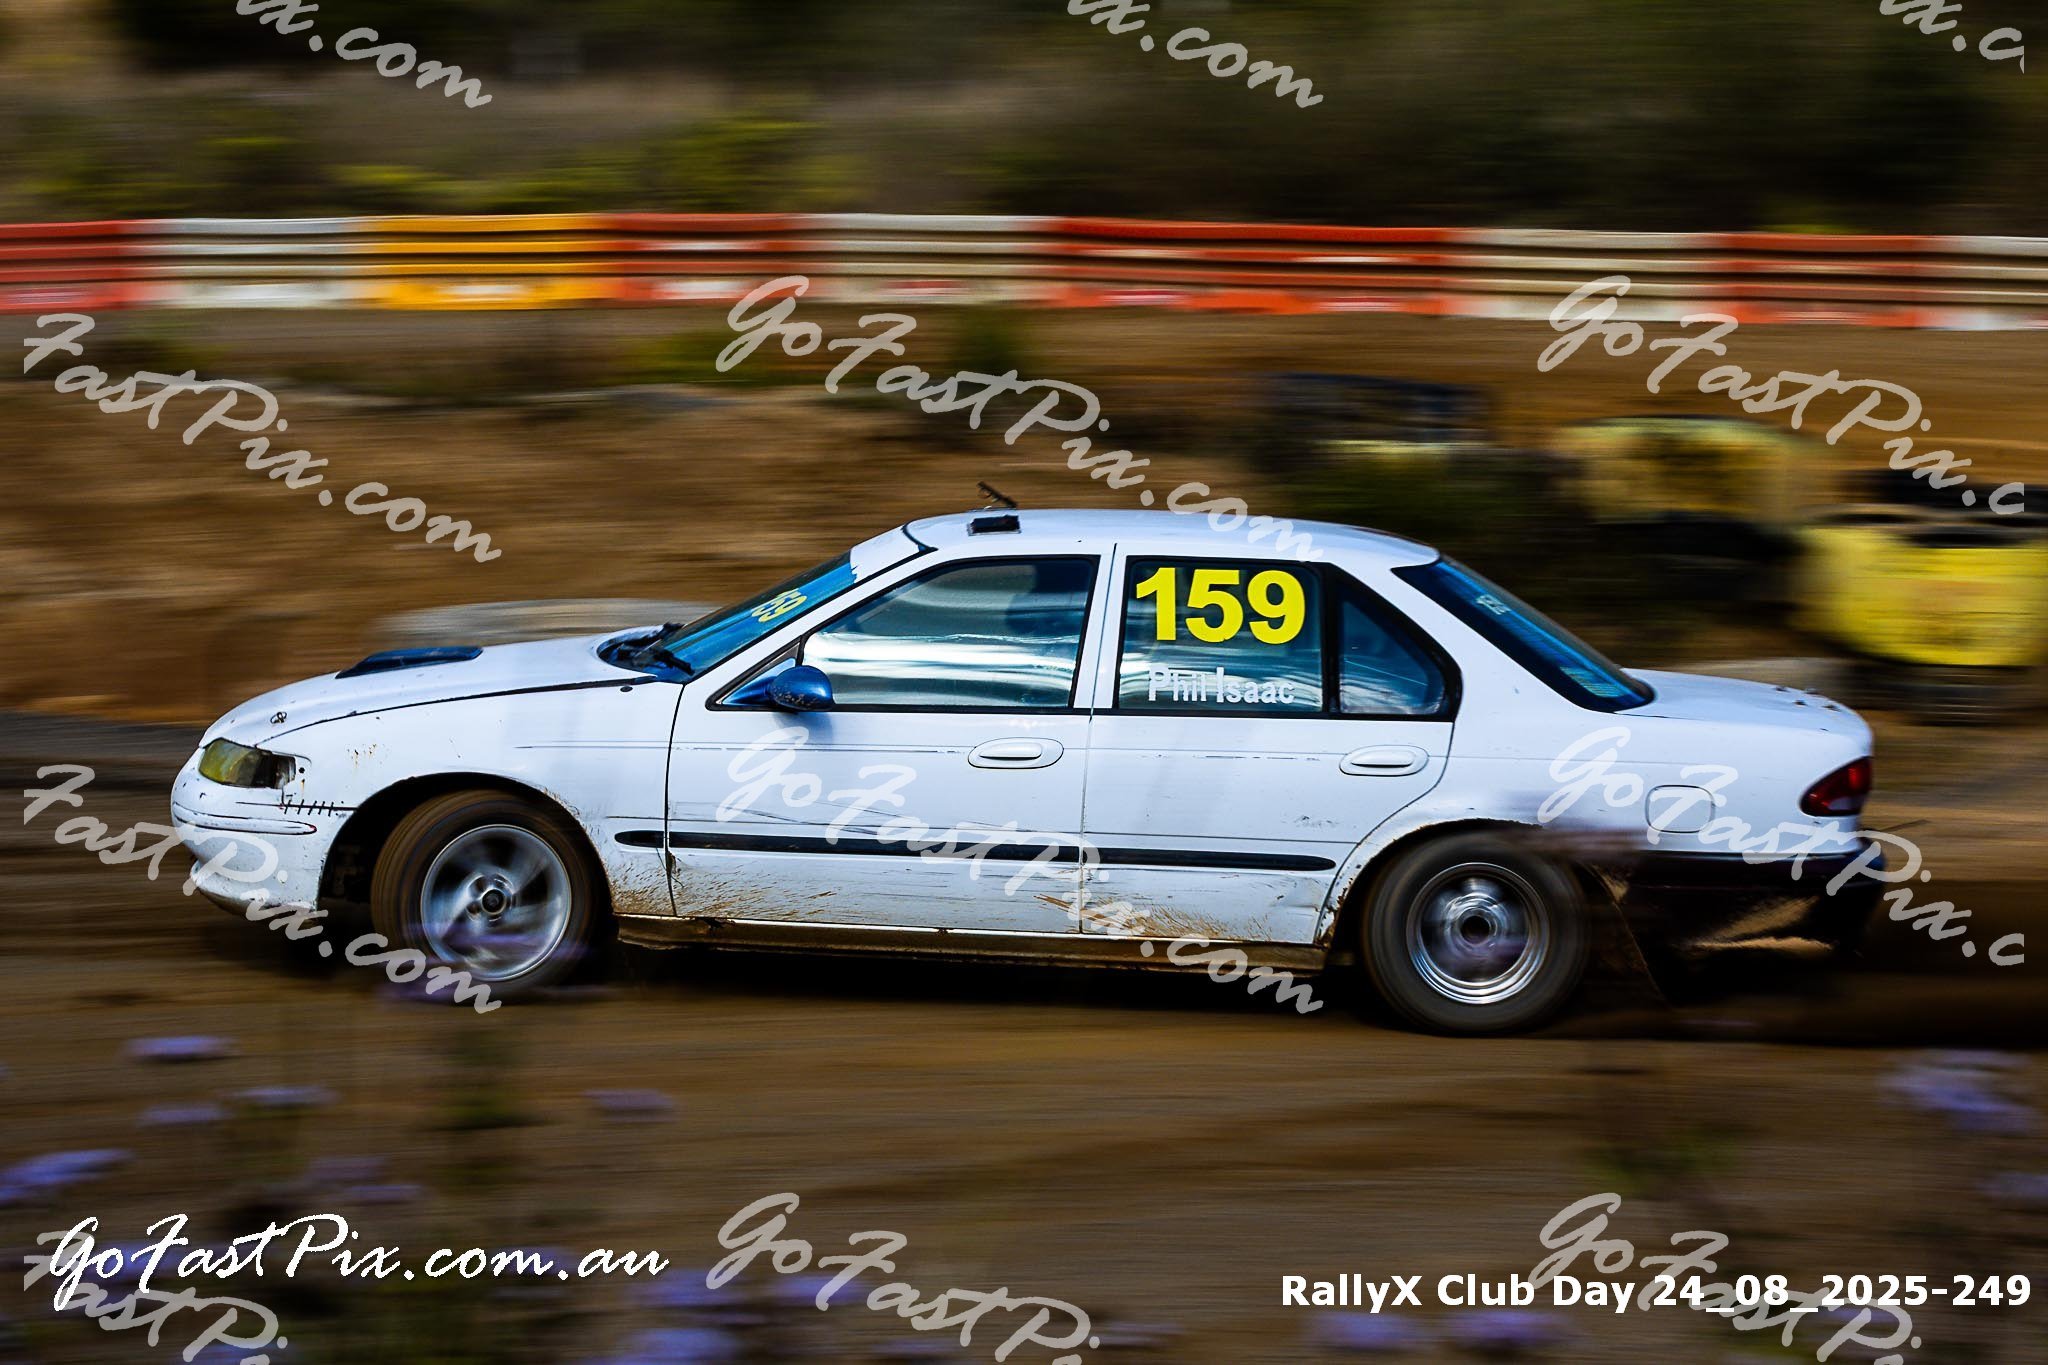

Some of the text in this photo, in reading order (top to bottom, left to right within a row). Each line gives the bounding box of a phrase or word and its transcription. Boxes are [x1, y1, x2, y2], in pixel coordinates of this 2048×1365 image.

[750, 588, 807, 622] 159
[1136, 567, 1305, 644] 159
[1149, 664, 1294, 704] Phil Isaac
